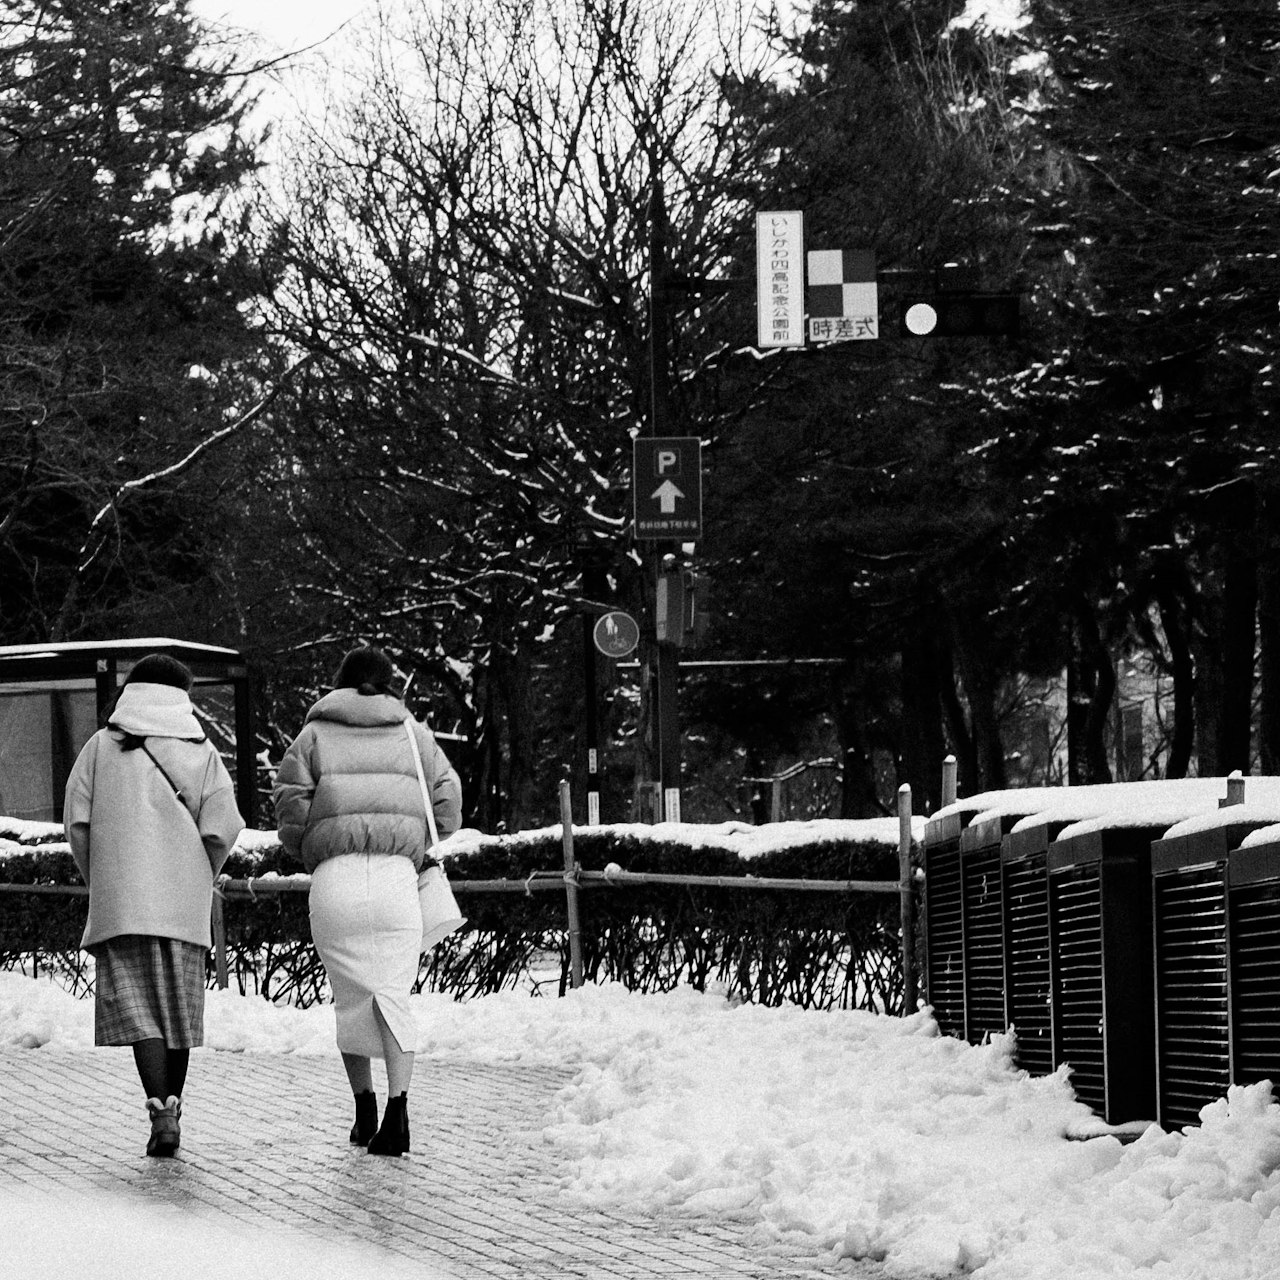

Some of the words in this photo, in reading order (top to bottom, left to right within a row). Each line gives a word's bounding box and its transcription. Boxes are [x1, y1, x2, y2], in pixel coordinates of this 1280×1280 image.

[771, 218, 789, 341] いしかわ四高記念公園前
[812, 317, 875, 338] 時差式
[658, 451, 676, 474] P
